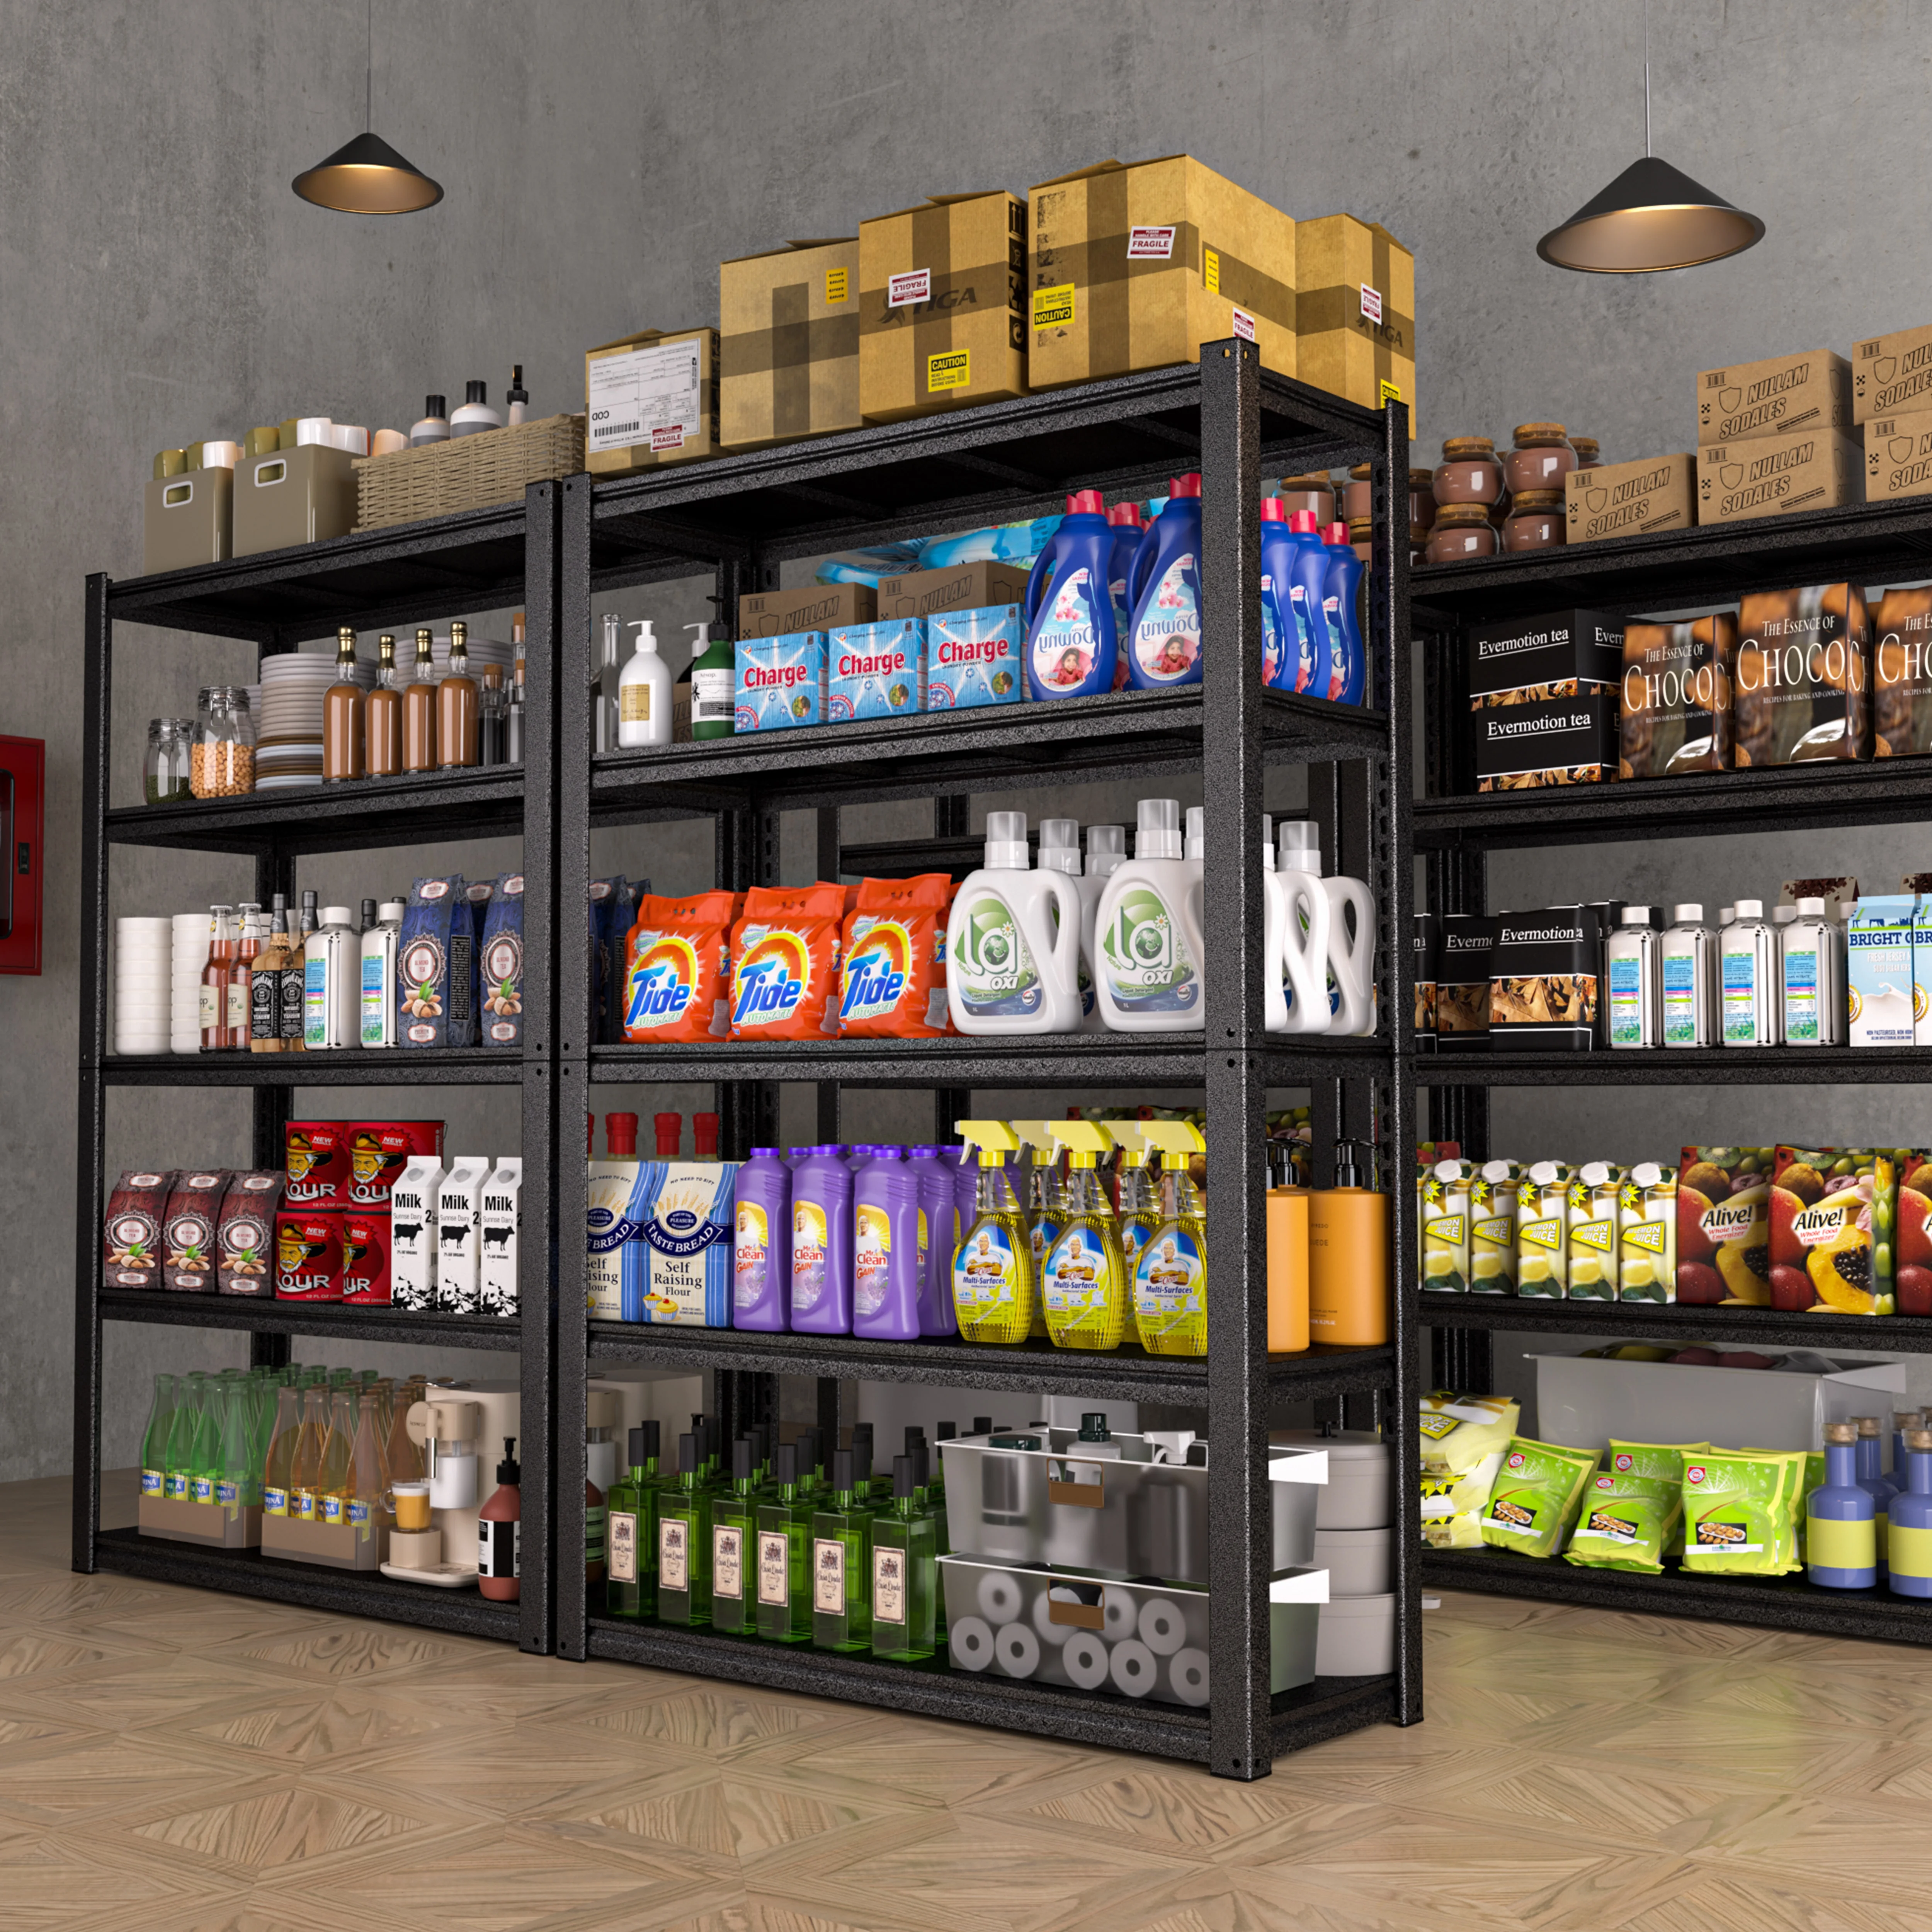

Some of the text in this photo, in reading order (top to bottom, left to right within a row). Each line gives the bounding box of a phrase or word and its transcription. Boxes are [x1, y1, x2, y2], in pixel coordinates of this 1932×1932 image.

[893, 280, 926, 292] FRAGILE
[1035, 308, 1071, 324] CAUTION
[932, 356, 966, 370] CAUTION
[1902, 343, 1932, 374] NUL
[1747, 363, 1809, 405] NULLAM
[592, 410, 609, 421] COD
[1719, 397, 1787, 440] SODALES
[653, 434, 681, 444] FRAGILE
[1750, 442, 1814, 482] NULLAM
[1889, 458, 1932, 492] SODA
[1612, 466, 1670, 505] NULLAM
[1721, 476, 1790, 516] SODALES
[1586, 499, 1649, 538] SODALES
[920, 575, 973, 616] NULLAM
[784, 595, 840, 634] NULLAM
[1762, 616, 1835, 637] THE ESSENCE OF
[1478, 629, 1569, 656] Evermotion tea
[938, 638, 1009, 663] Charge
[1645, 643, 1704, 663] THE ESSENCE OF
[838, 652, 905, 676] Charge
[743, 664, 808, 688] Charge
[1487, 714, 1591, 736] Evermotion tea
[1501, 926, 1575, 942] Evermotion
[1849, 932, 1902, 946] BRIGHT
[1867, 951, 1906, 963] FRESH JERSEY
[840, 952, 904, 1018] Tide
[990, 976, 1019, 990] OXI
[1143, 970, 1173, 986] OXI
[625, 965, 690, 1027] Tide
[733, 960, 802, 1023] Tide
[742, 1008, 795, 1026] AUTOMATIC
[849, 1002, 898, 1020] AUTOMATIC
[634, 1011, 684, 1029] AUTOMATIC
[383, 1136, 404, 1144] NEW
[395, 1194, 422, 1209] Milk
[442, 1195, 469, 1210] Milk
[485, 1196, 513, 1212] Milk
[410, 1213, 422, 1221] Dairy
[425, 1209, 432, 1223] 2
[472, 1211, 479, 1225] 2
[501, 1217, 514, 1225] Dairy
[1436, 1218, 1460, 1227] LEMON
[1702, 1206, 1753, 1228] Alive!
[1795, 1208, 1843, 1230] Alive!
[1483, 1219, 1508, 1228] LEMON
[1531, 1222, 1556, 1231] LEMON
[1583, 1223, 1609, 1233] LEMON
[1634, 1225, 1661, 1235] LEMON
[592, 1224, 629, 1249] BREAD
[648, 1224, 713, 1253] TASTE BREAD
[1435, 1226, 1459, 1238] JUICE
[1482, 1228, 1507, 1239] JUICE
[1529, 1230, 1556, 1242] JUICE
[1581, 1232, 1607, 1244] JUICE
[1712, 1231, 1746, 1241] Energizer
[1800, 1230, 1821, 1238] Whole
[1633, 1234, 1660, 1247] JUICE
[1803, 1235, 1835, 1244] Energizer
[736, 1248, 764, 1260] Clean
[794, 1249, 823, 1260] Clean
[856, 1253, 886, 1265] Clean
[665, 1261, 690, 1274] Self
[736, 1261, 754, 1274] GAIN
[794, 1262, 813, 1274] GAIN
[856, 1266, 876, 1279] GAIN
[588, 1270, 619, 1285] ising
[654, 1272, 702, 1289] Raising
[963, 1276, 1005, 1284] Multi-Surfaces
[588, 1282, 607, 1292] lour
[665, 1286, 691, 1296] Flour
[1053, 1281, 1098, 1289] Multi-Surfaces
[1145, 1285, 1193, 1293] Multi-Surfaces
